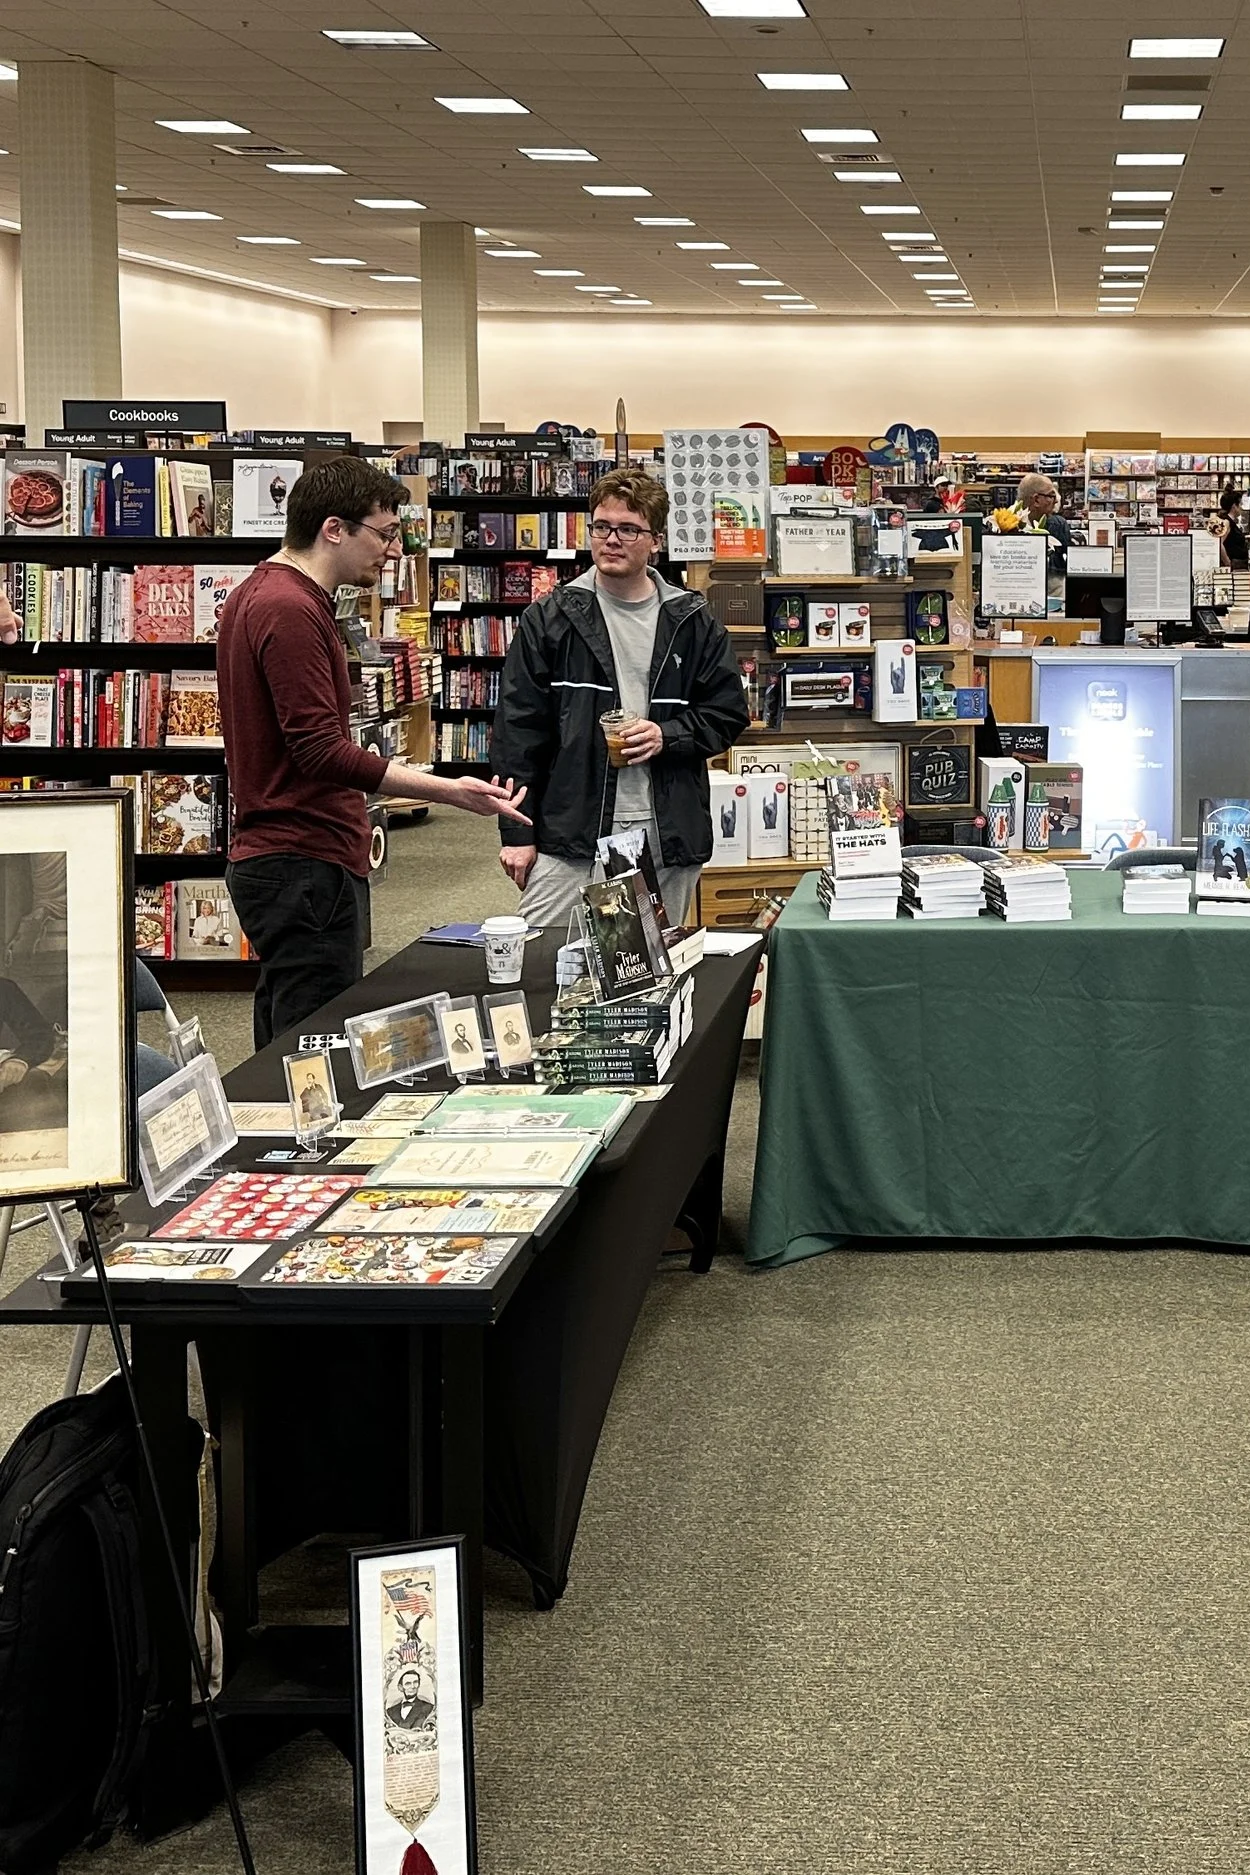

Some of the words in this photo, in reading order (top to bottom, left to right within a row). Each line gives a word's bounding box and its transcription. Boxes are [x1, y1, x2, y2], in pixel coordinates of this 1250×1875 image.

[109, 409, 179, 422] Cookbooks
[51, 434, 74, 443] Young
[76, 434, 96, 443] Adult
[259, 435, 283, 446] Young
[284, 435, 305, 445] Adult
[470, 438, 494, 448] Young
[495, 438, 516, 447] Adult
[123, 501, 143, 509] Baking
[785, 528, 814, 536] FATHER
[825, 528, 846, 536] YEAR
[200, 576, 213, 590] 50
[27, 574, 37, 613] COOKIES
[148, 583, 190, 602] DESI
[214, 588, 227, 602] 50
[148, 602, 191, 617] BAKES
[1018, 736, 1042, 744] CAMP
[925, 760, 954, 778] PUB
[921, 773, 957, 791] QUIZ
[1202, 822, 1219, 836] LIFE
[836, 840, 857, 849] THE
[859, 838, 887, 847] HATS
[135, 906, 164, 914] BRING
[615, 951, 641, 967] Tyler
[615, 962, 648, 981] MADISON
